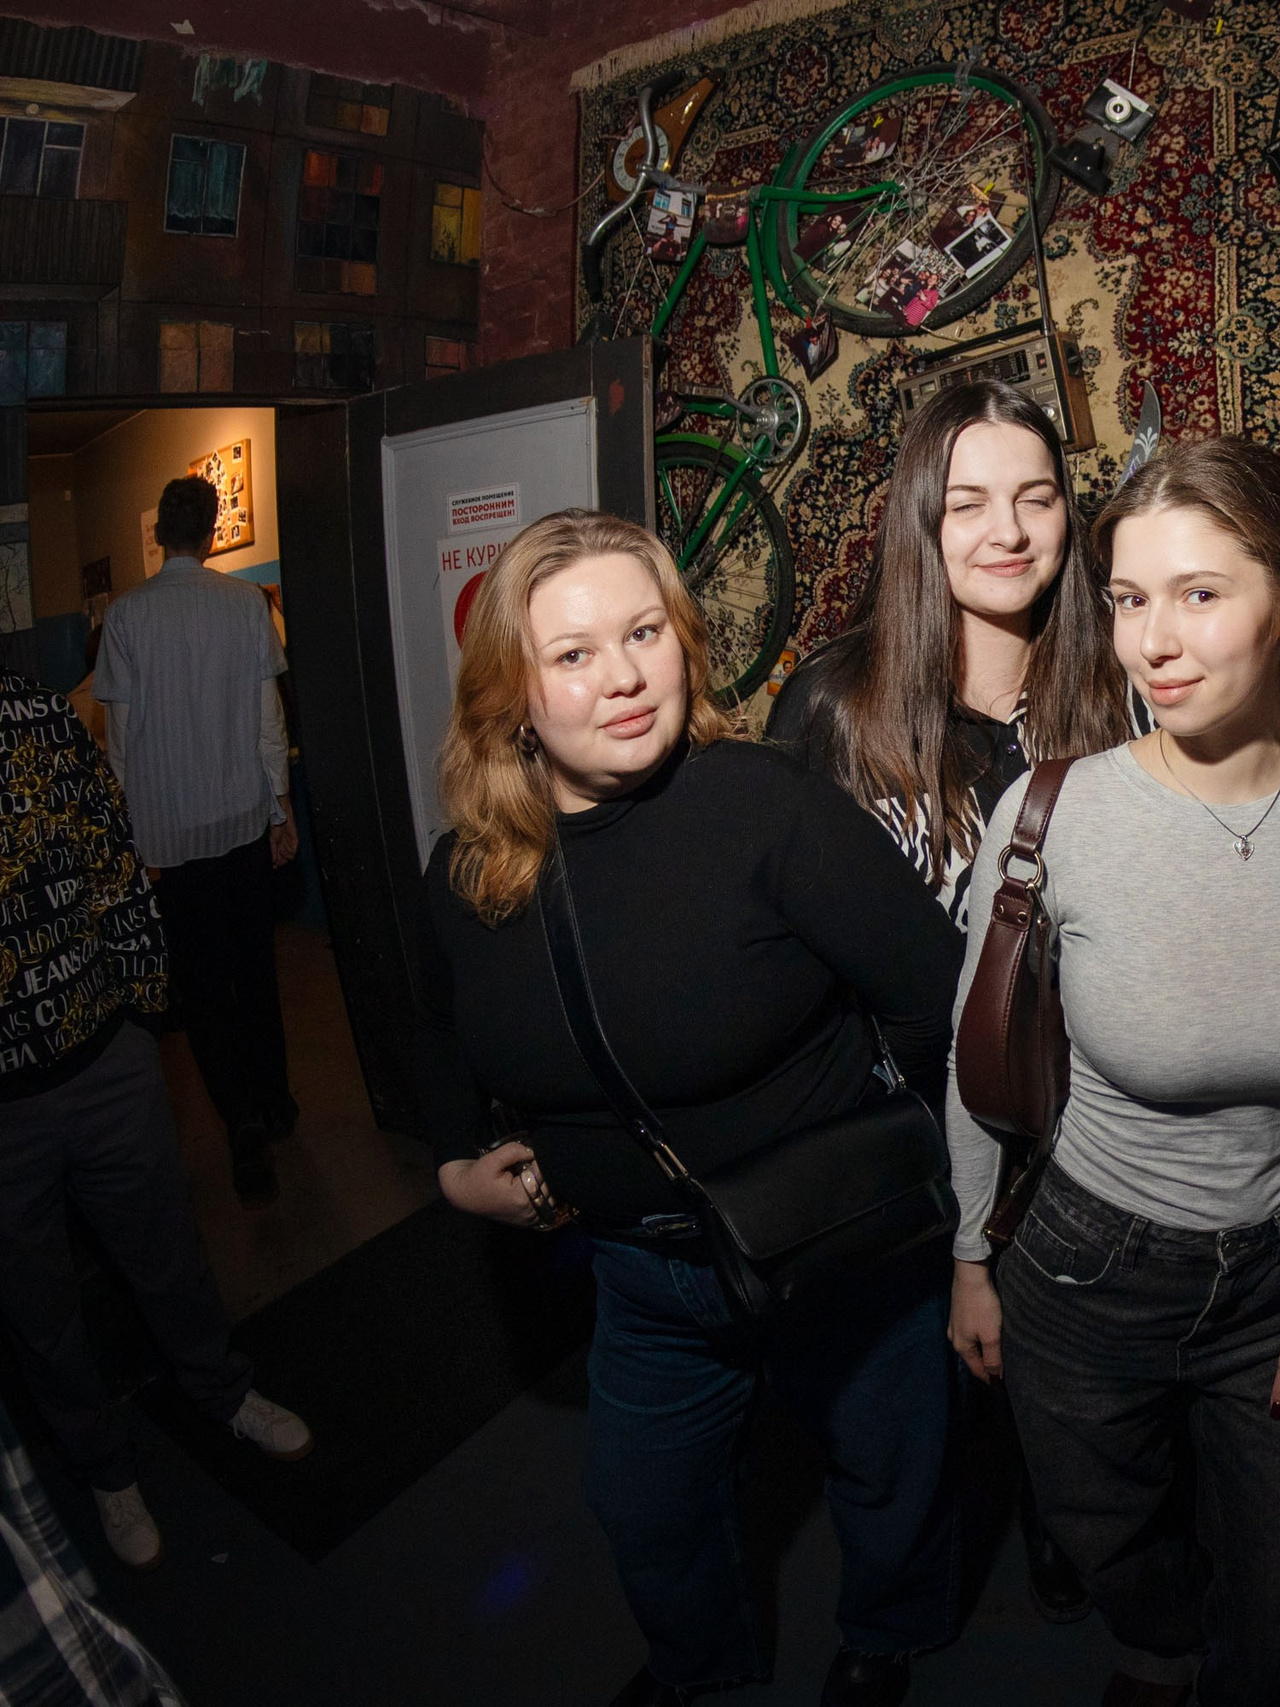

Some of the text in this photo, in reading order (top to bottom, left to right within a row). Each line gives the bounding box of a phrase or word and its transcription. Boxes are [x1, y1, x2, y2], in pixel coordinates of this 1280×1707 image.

[451, 490, 514, 506] СЛУЖЕБНОЕ ПОМЕЩЕНИЕ
[451, 499, 514, 516] ПОСТОРОННИМ
[452, 515, 469, 525] ВХОД
[442, 550, 462, 571] НЕ
